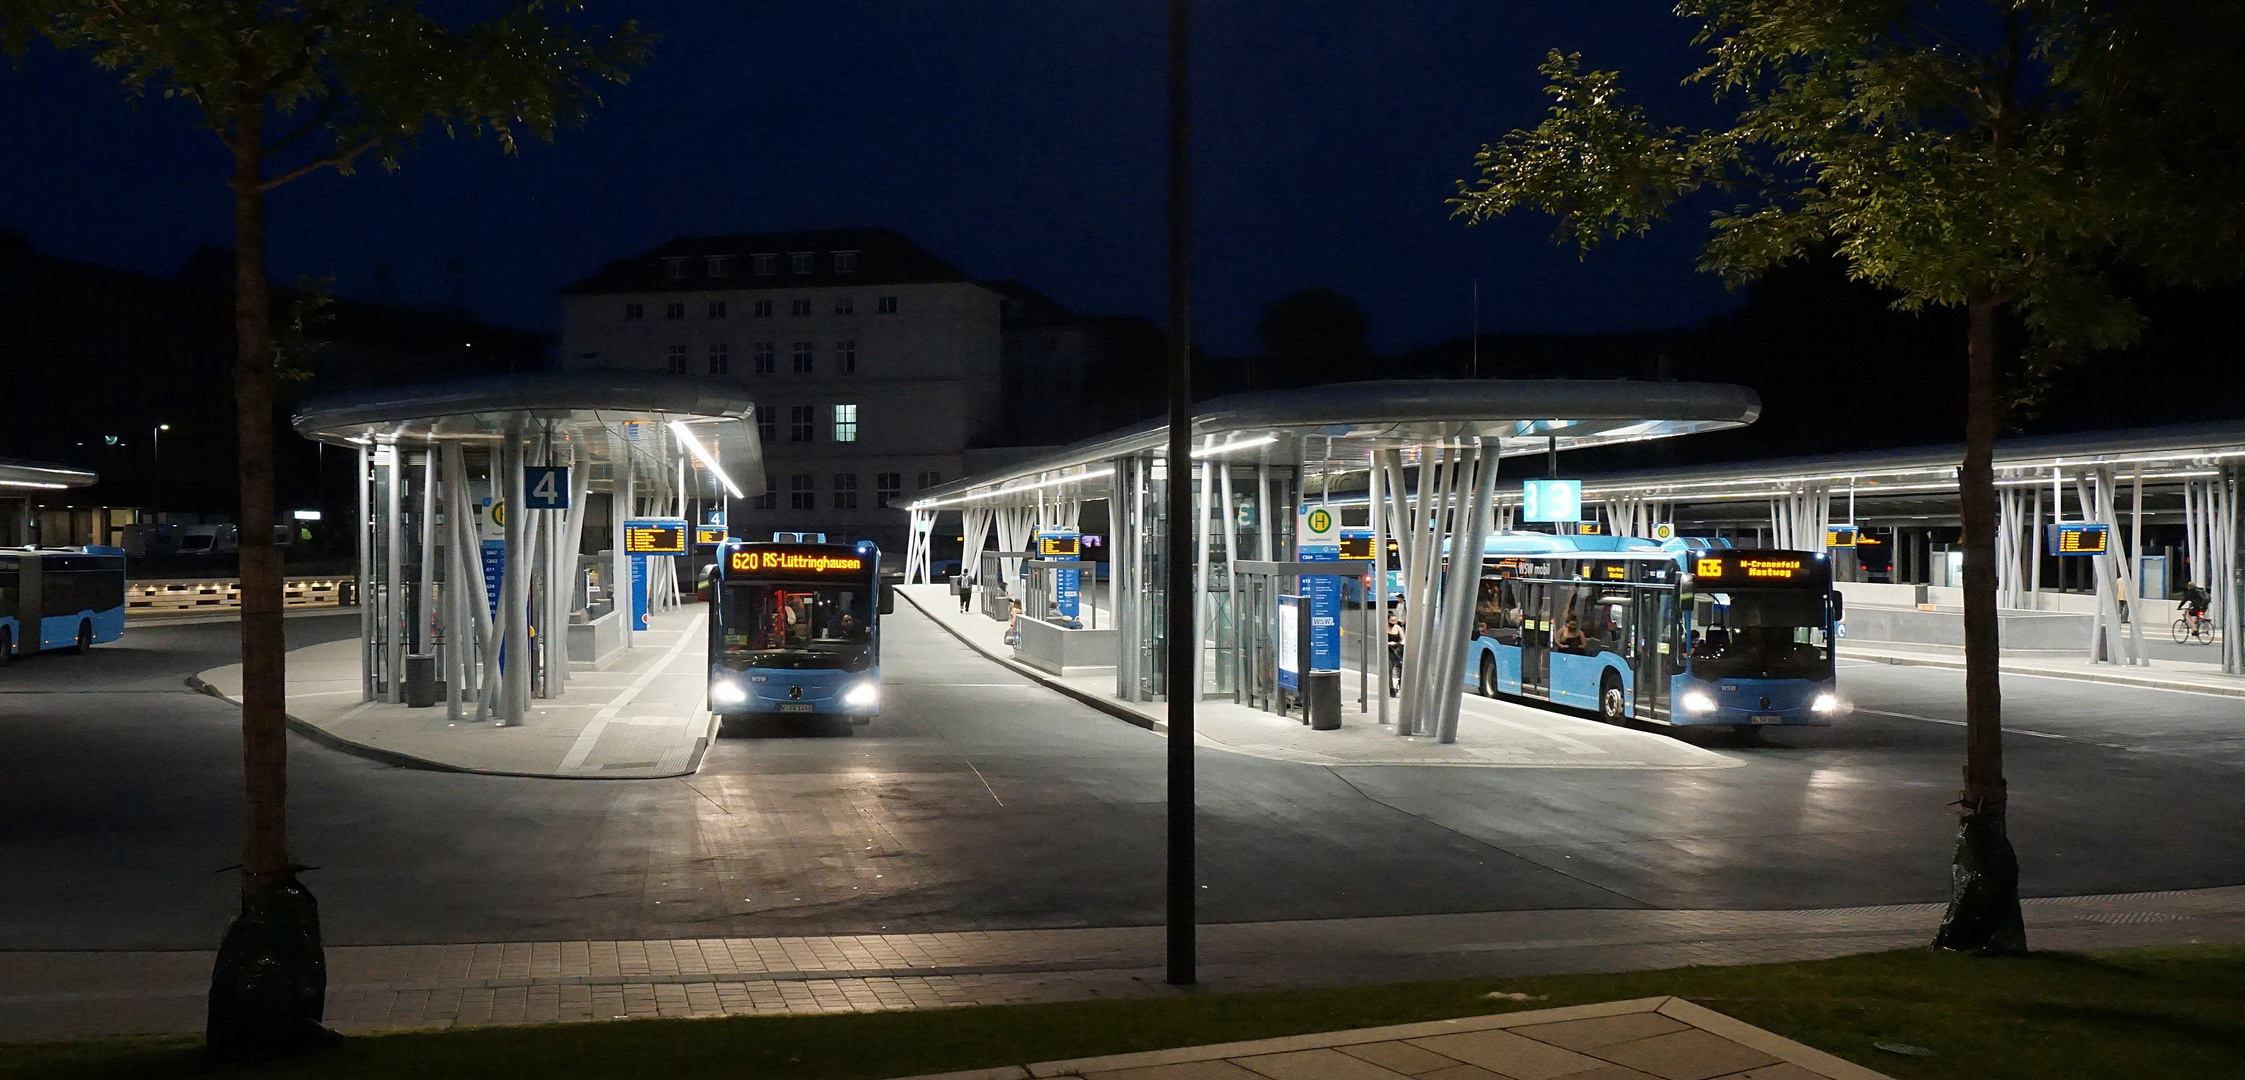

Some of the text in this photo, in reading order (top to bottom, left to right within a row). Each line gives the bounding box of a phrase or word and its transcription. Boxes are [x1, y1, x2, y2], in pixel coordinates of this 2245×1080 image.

[532, 471, 558, 505] 4
[1527, 482, 1538, 518] 3
[1549, 482, 1572, 518] 3
[710, 512, 721, 525] 4
[1315, 514, 1325, 529] H
[732, 552, 860, 572] 620 RS-Lüttringhausen
[1518, 562, 1551, 576] WSW mobil
[1697, 559, 1800, 577] 635 W-Cronenfeld
[1748, 567, 1792, 578] Mastweg
